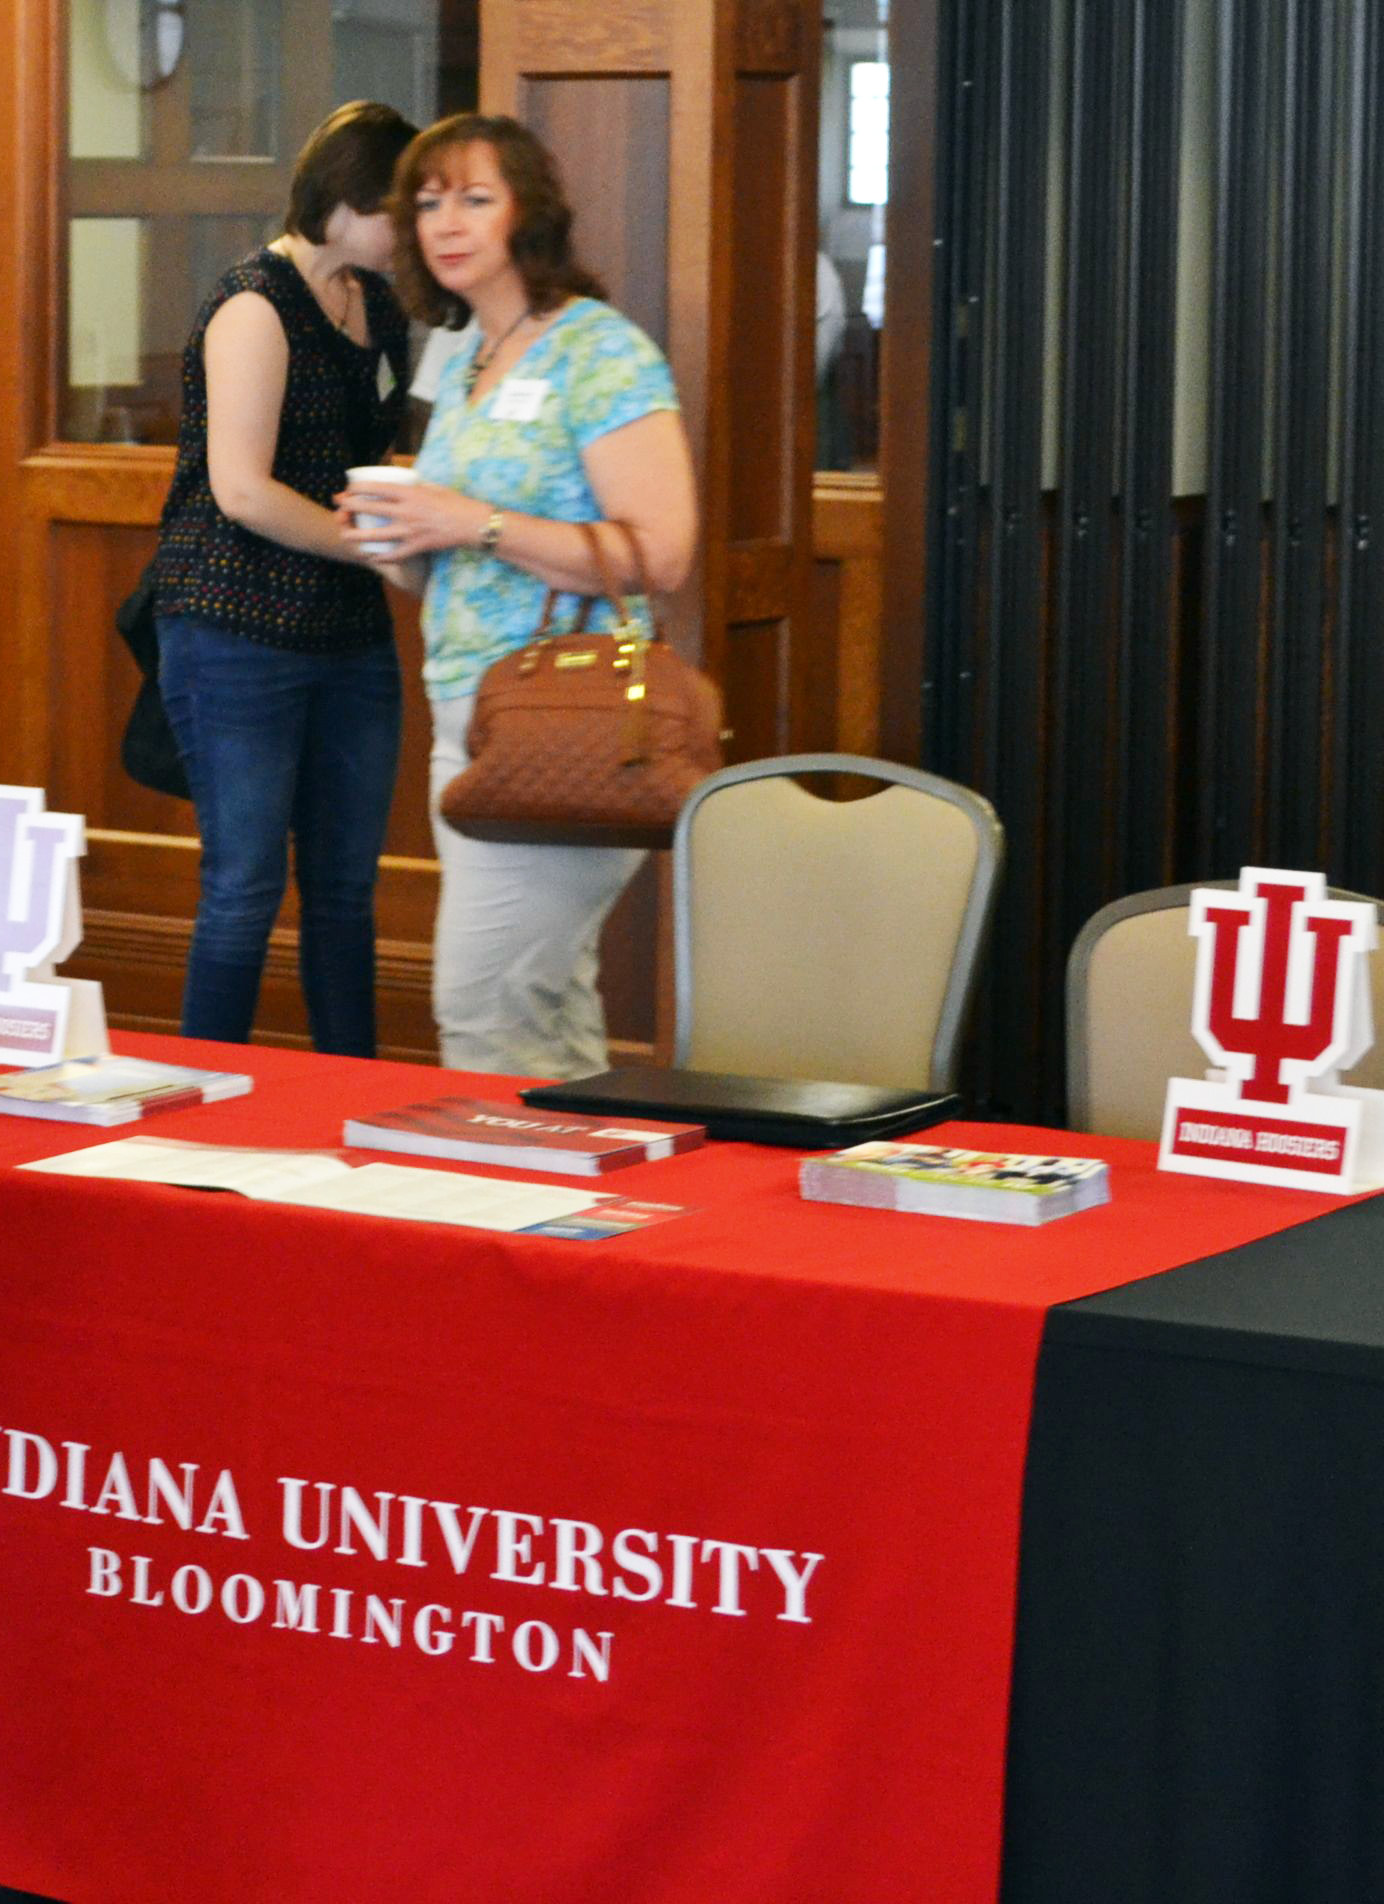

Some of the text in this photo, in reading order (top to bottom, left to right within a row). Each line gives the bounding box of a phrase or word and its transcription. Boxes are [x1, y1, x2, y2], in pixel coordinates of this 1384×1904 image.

[1179, 1122, 1340, 1160] INDIANA HOOSIERS
[85, 1546, 615, 1682] BLOOMINGTON
[276, 1477, 825, 1624] UNIVERSITY
